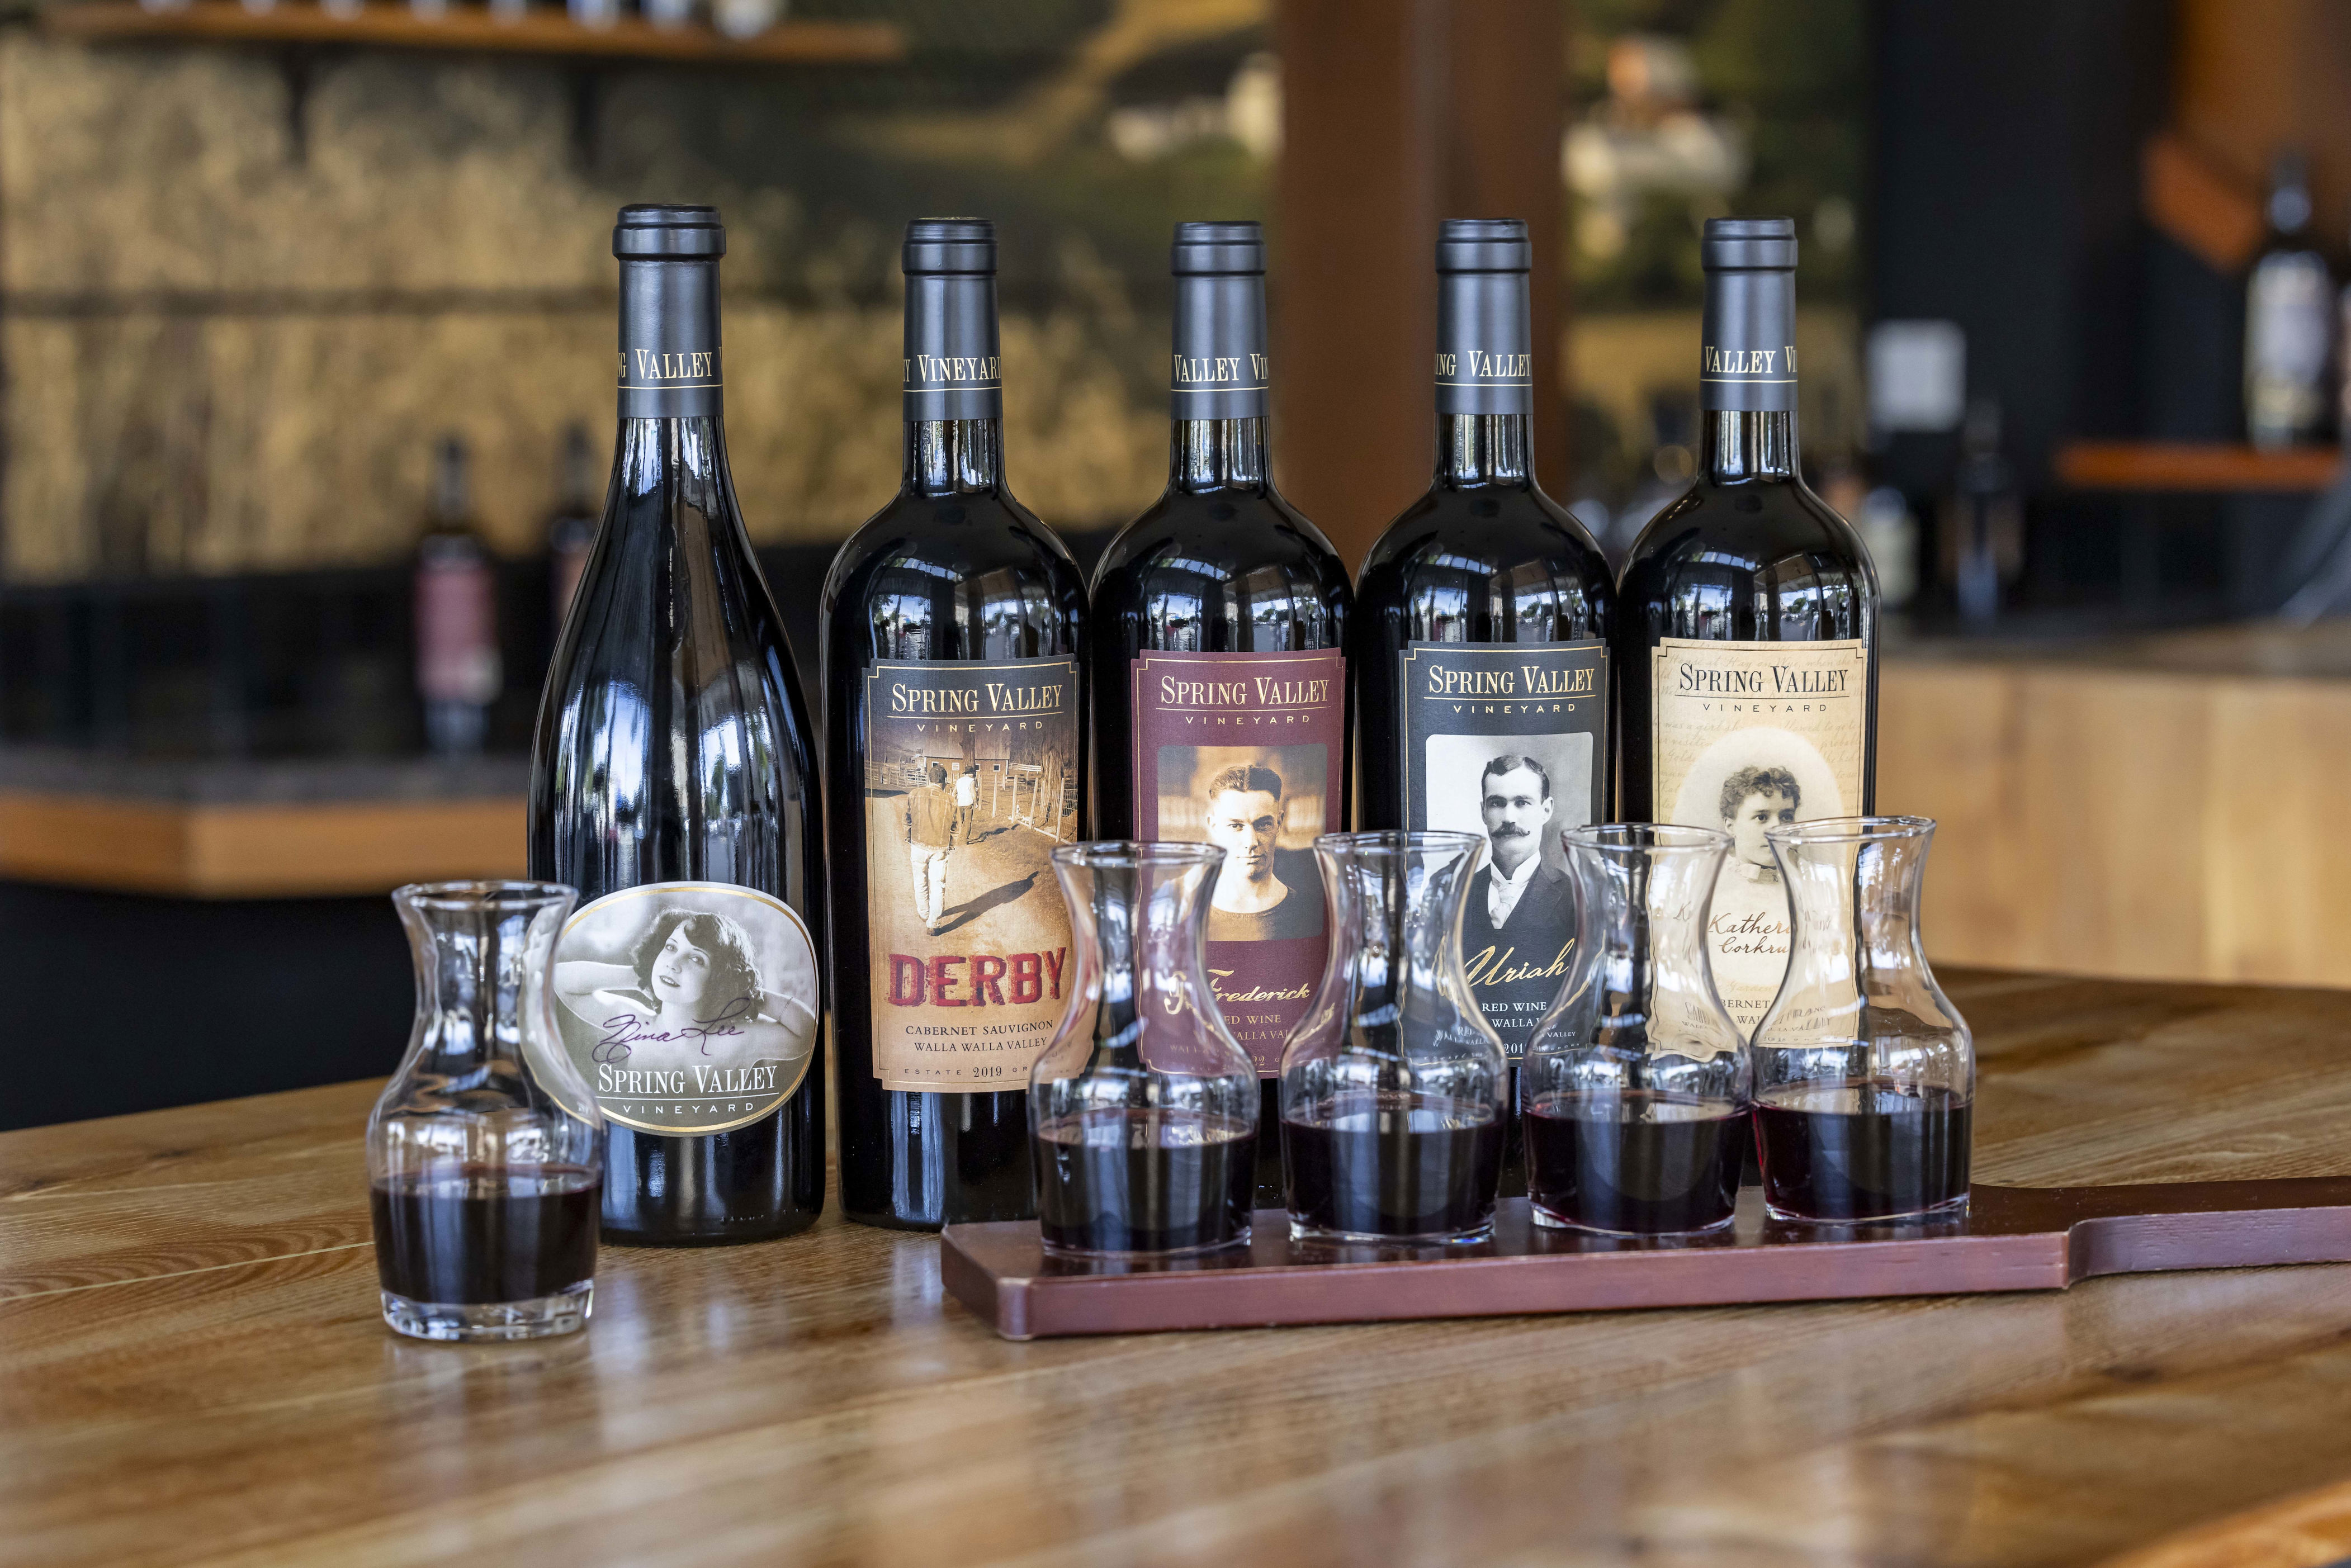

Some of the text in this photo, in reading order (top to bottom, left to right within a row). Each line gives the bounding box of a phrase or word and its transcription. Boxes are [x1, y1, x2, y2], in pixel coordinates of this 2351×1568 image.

[635, 349, 712, 379] VALLEY
[1436, 350, 1530, 377] ING VALLEY
[1705, 346, 1776, 373] VALLEY
[1174, 354, 1240, 382] VALLEY
[1430, 665, 1595, 694] SPRING VALLEY
[1680, 663, 1763, 693] SPRING
[1770, 666, 1848, 693] VALLEY
[892, 683, 1063, 712] SPRING VALLEY
[1161, 676, 1330, 705] SPRING VALLEY
[1453, 704, 1576, 714] VINEYARD
[1703, 704, 1827, 712] VINEYARD
[917, 721, 1043, 732] VINEYARD
[1185, 715, 1309, 725] VINEYARD
[1719, 936, 1788, 954] Corkru
[1464, 938, 1575, 987] Uriah
[886, 947, 1067, 1007] DERBY
[1207, 969, 1311, 1001] Frederick
[1482, 1002, 1547, 1012] RED WINE
[1721, 999, 1770, 1008] BERNET
[906, 1020, 1053, 1036] CABERNET SAUVIGNON
[1224, 1015, 1281, 1025] ED WINE
[1492, 1018, 1534, 1027] WALLA
[1234, 1031, 1266, 1040] ALLA
[914, 1037, 1047, 1051] WALLA WALLA VALLEY
[1503, 1043, 1524, 1054] 201
[599, 1063, 777, 1093] SPRING VALLEY
[973, 1066, 1002, 1078] 2019
[623, 1103, 753, 1114] VINEYARD
